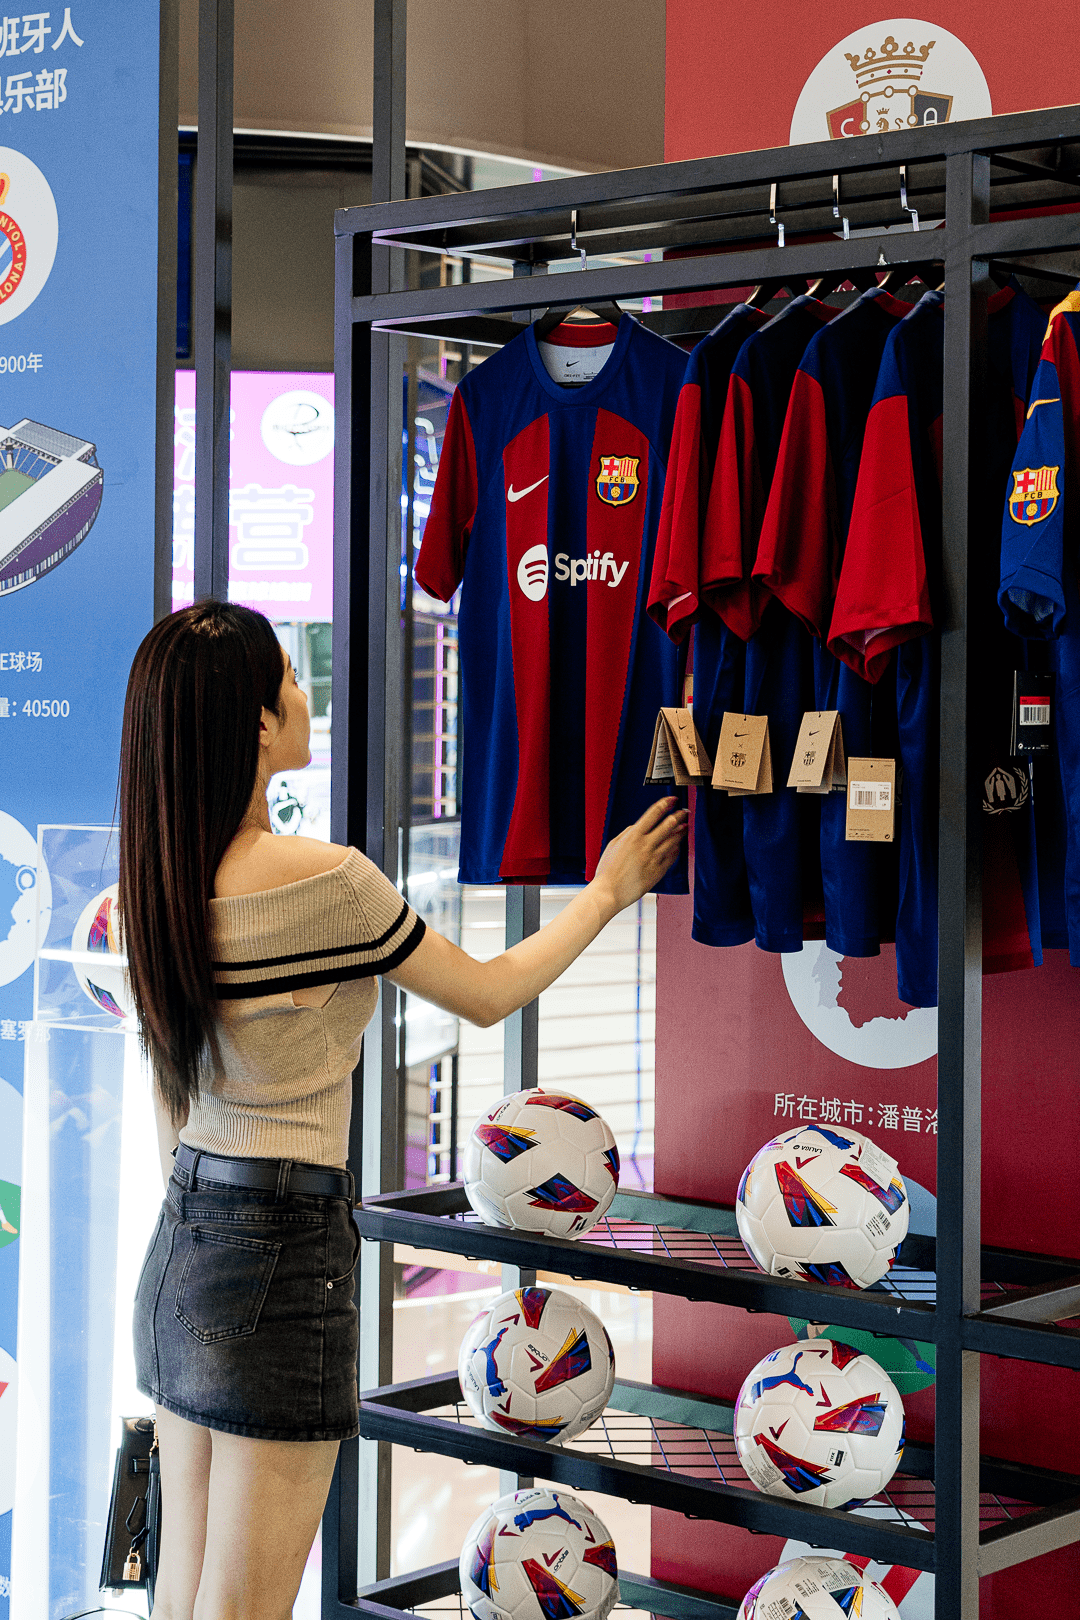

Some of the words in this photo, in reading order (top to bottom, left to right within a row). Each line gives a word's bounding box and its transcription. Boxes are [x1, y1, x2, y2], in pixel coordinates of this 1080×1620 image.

[0, 68, 68, 115] 乐部
[0, 351, 44, 373] 900年
[608, 475, 626, 484] FCB
[1023, 491, 1044, 500] FCB
[554, 549, 630, 588] Sptify
[22, 699, 70, 717] 40500
